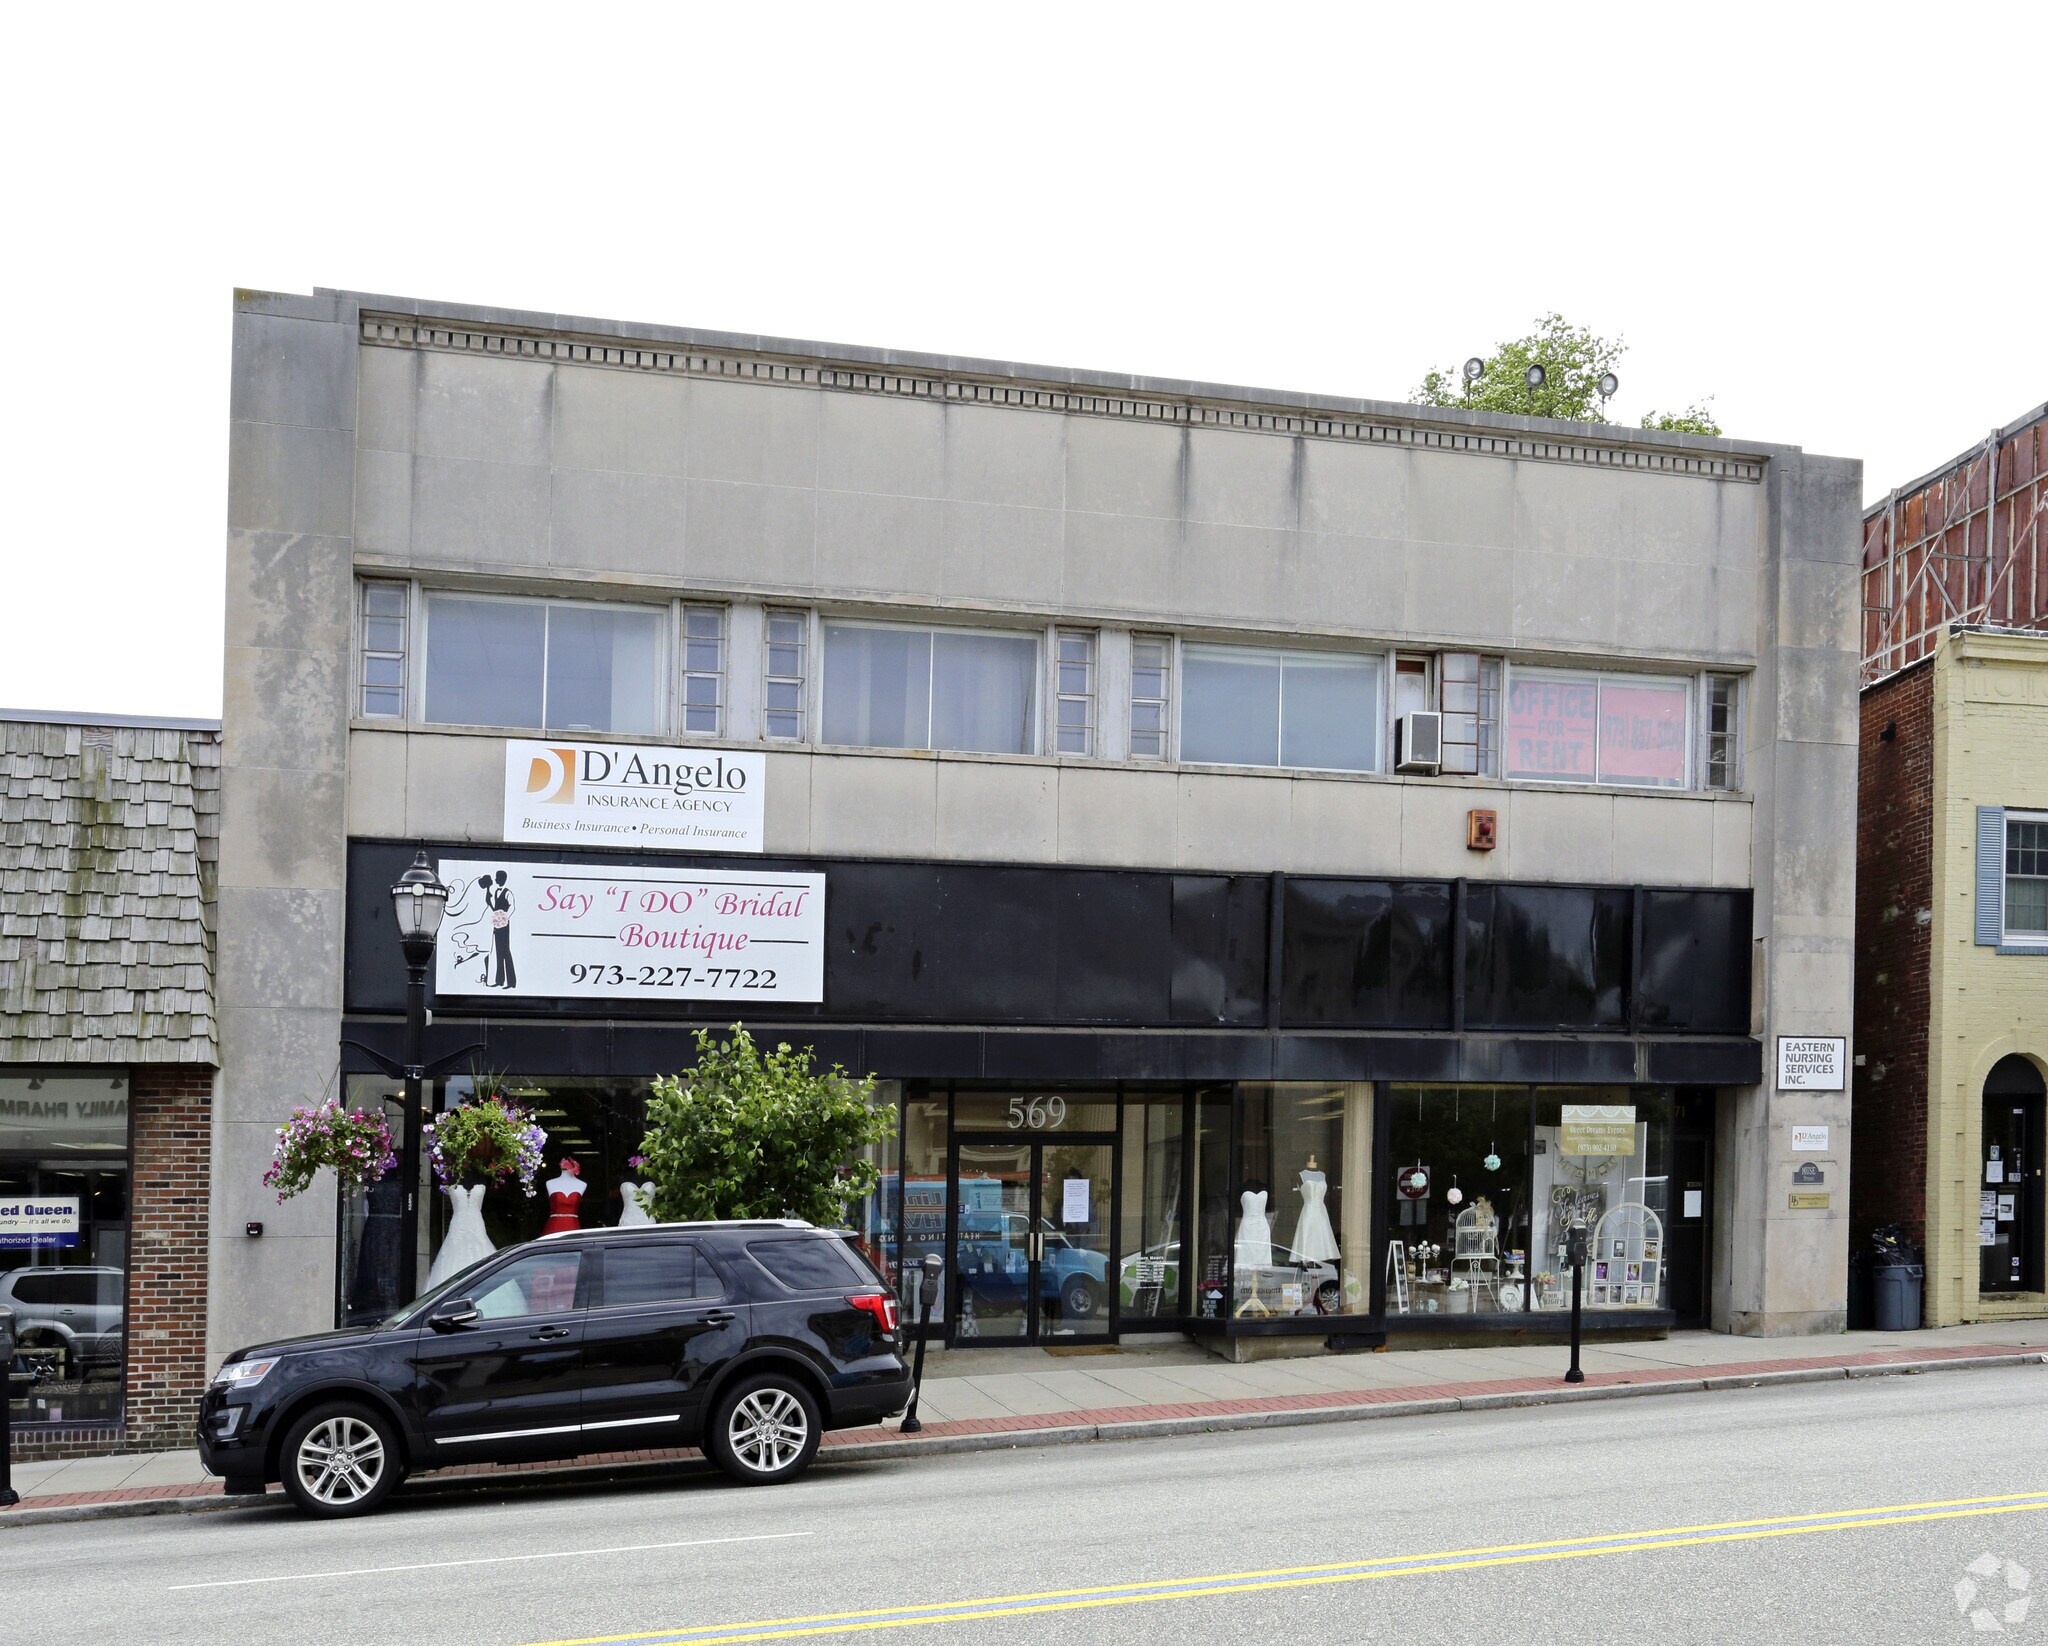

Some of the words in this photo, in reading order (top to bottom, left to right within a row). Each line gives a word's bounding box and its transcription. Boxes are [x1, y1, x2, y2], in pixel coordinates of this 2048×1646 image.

[1510, 686, 1593, 720] OFFICE
[1537, 719, 1565, 737] FOR
[1518, 738, 1584, 771] RENT
[580, 750, 747, 796] D'Angelo
[587, 794, 670, 810] INSURANCE
[672, 798, 733, 813] AGENCY
[522, 817, 571, 831] Business
[574, 819, 630, 834] Insurance
[640, 822, 690, 837] Personal
[692, 824, 748, 839] Insurance
[537, 884, 593, 919] Say
[714, 890, 810, 918] Bridal
[619, 923, 749, 958] Boutique
[570, 962, 778, 990] 973-227-7722
[1785, 1042, 1835, 1053] EASTERN
[1785, 1053, 1833, 1064] NURSING
[1785, 1064, 1834, 1075] SERVICES
[1784, 1075, 1806, 1085] INC.
[1007, 1095, 1067, 1129] 569
[1587, 1126, 1607, 1134] Dreams
[1802, 1132, 1827, 1141] D'Angelo
[24, 1204, 73, 1216] Queen
[32, 1236, 57, 1244] Dealer
